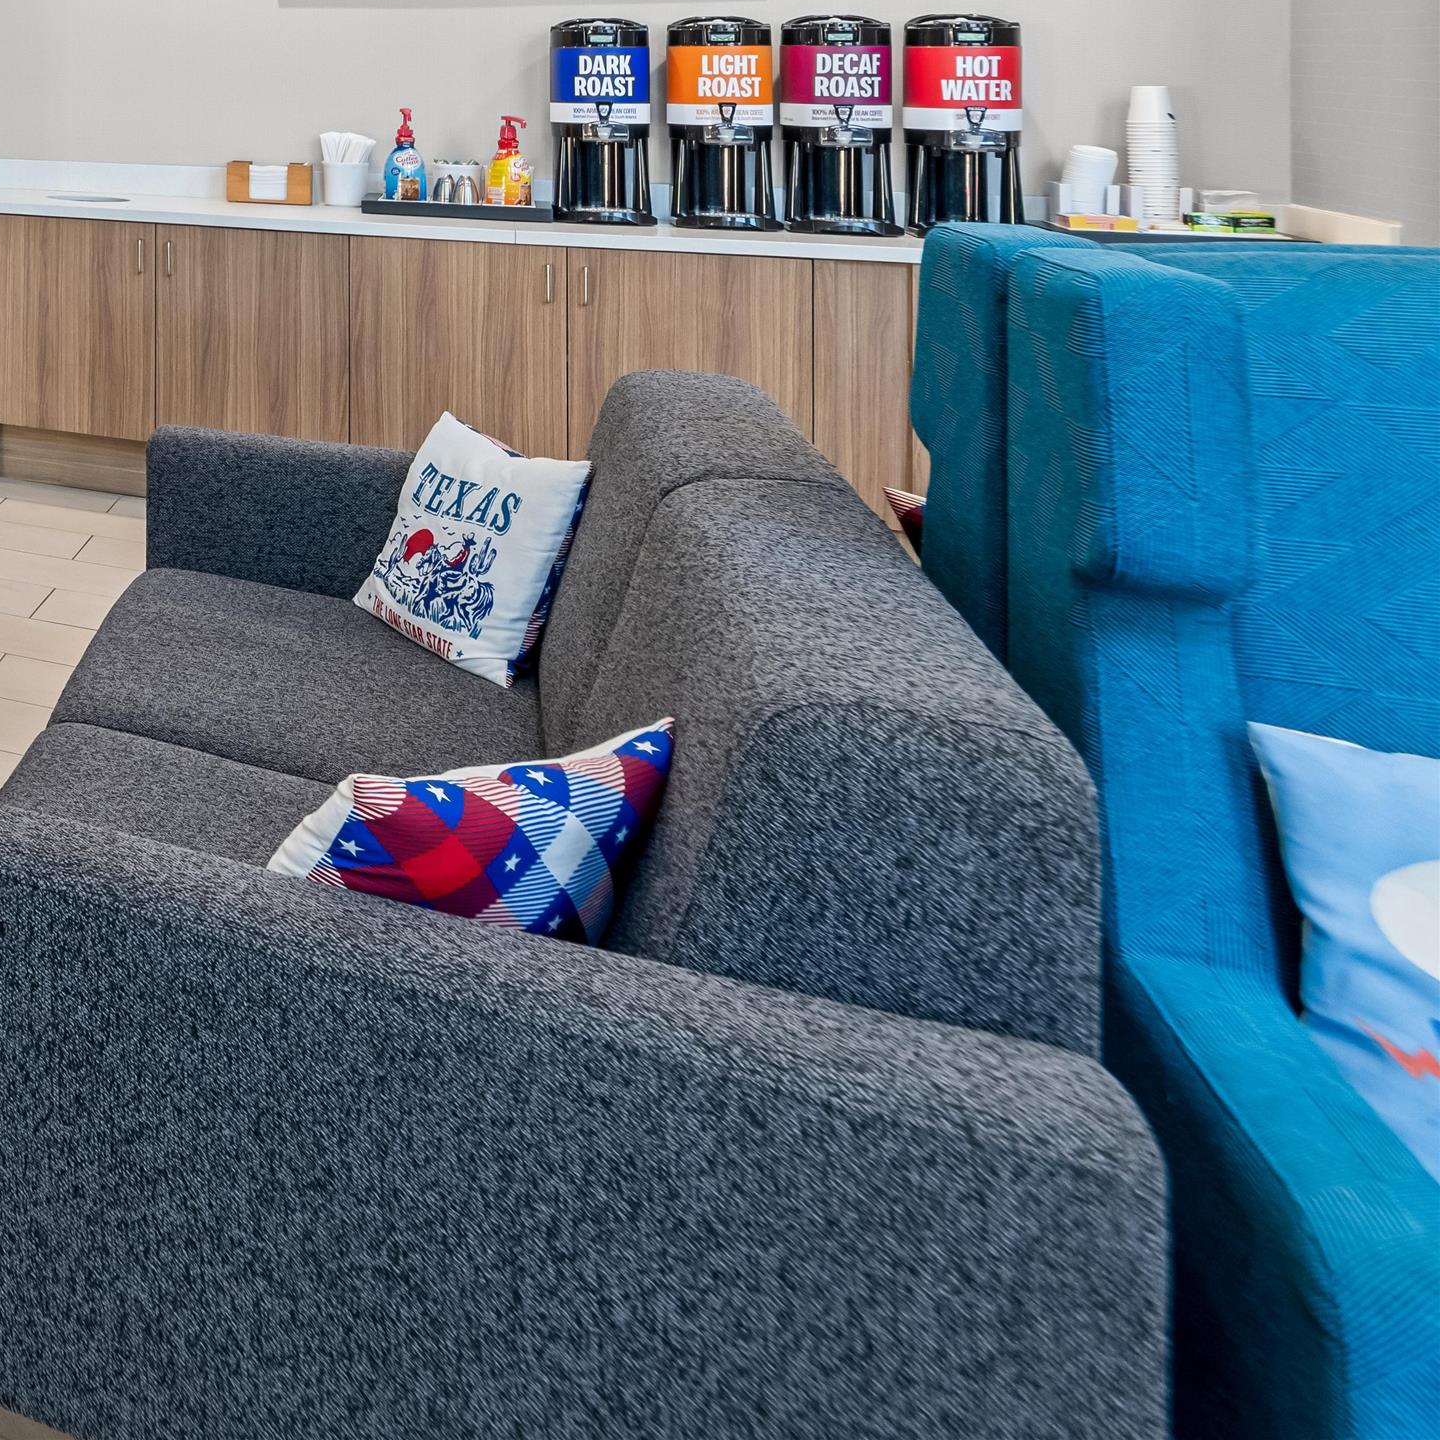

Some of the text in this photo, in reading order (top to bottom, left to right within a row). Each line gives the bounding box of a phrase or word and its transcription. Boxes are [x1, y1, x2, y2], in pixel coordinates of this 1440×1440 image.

[578, 54, 632, 75] DARK
[701, 54, 759, 75] LIGHT
[816, 53, 881, 75] DECAF
[955, 55, 1002, 77] HOT
[574, 76, 636, 97] ROAST
[697, 76, 762, 97] ROAST
[814, 76, 882, 97] ROAST
[940, 79, 1012, 101] WATER
[412, 462, 522, 536] TEXAS
[372, 595, 453, 660] THE LONE STAR STATE
